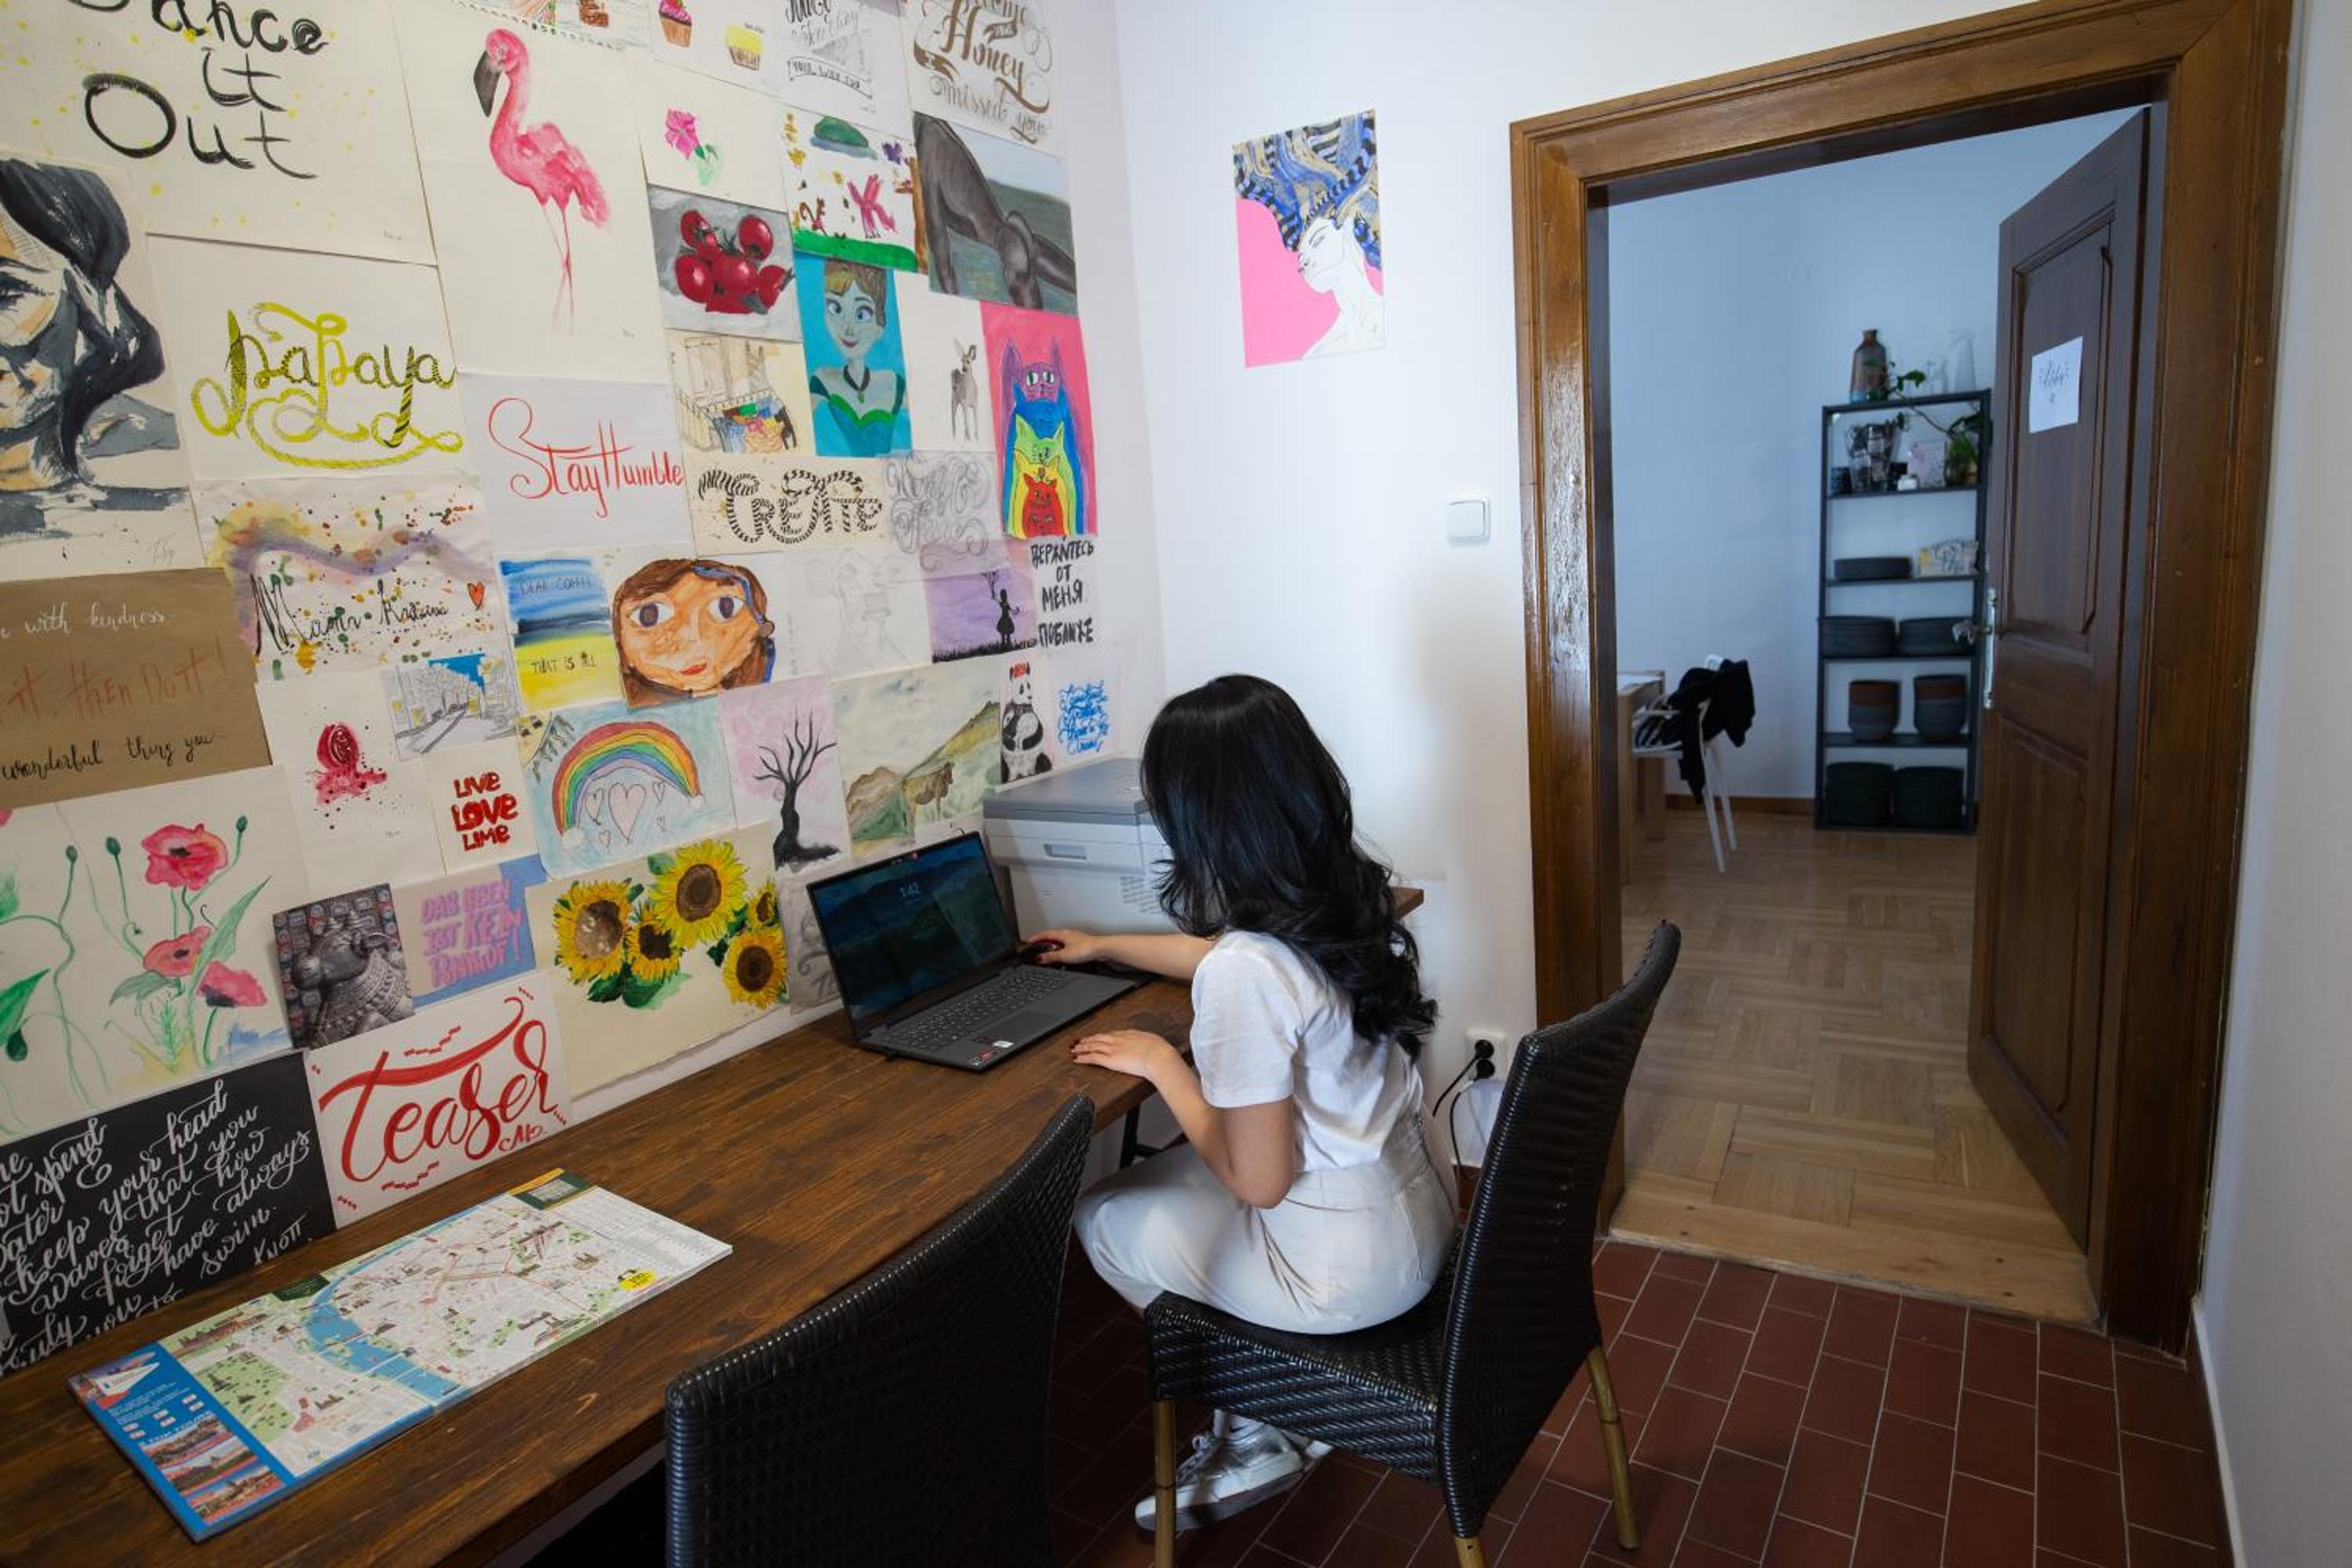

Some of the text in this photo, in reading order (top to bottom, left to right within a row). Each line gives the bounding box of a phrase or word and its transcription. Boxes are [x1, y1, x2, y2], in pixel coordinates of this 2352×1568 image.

[67, 0, 329, 55] ance
[82, 72, 320, 180] Out
[24, 601, 71, 636] with
[1042, 579, 1083, 612] МЕНЯ
[2, 739, 103, 782] wonderful
[4, 1078, 229, 1305] keep your head
[34, 1117, 107, 1204] spend
[124, 1142, 198, 1221] that
[151, 1218, 220, 1277] have
[212, 1130, 311, 1213] always
